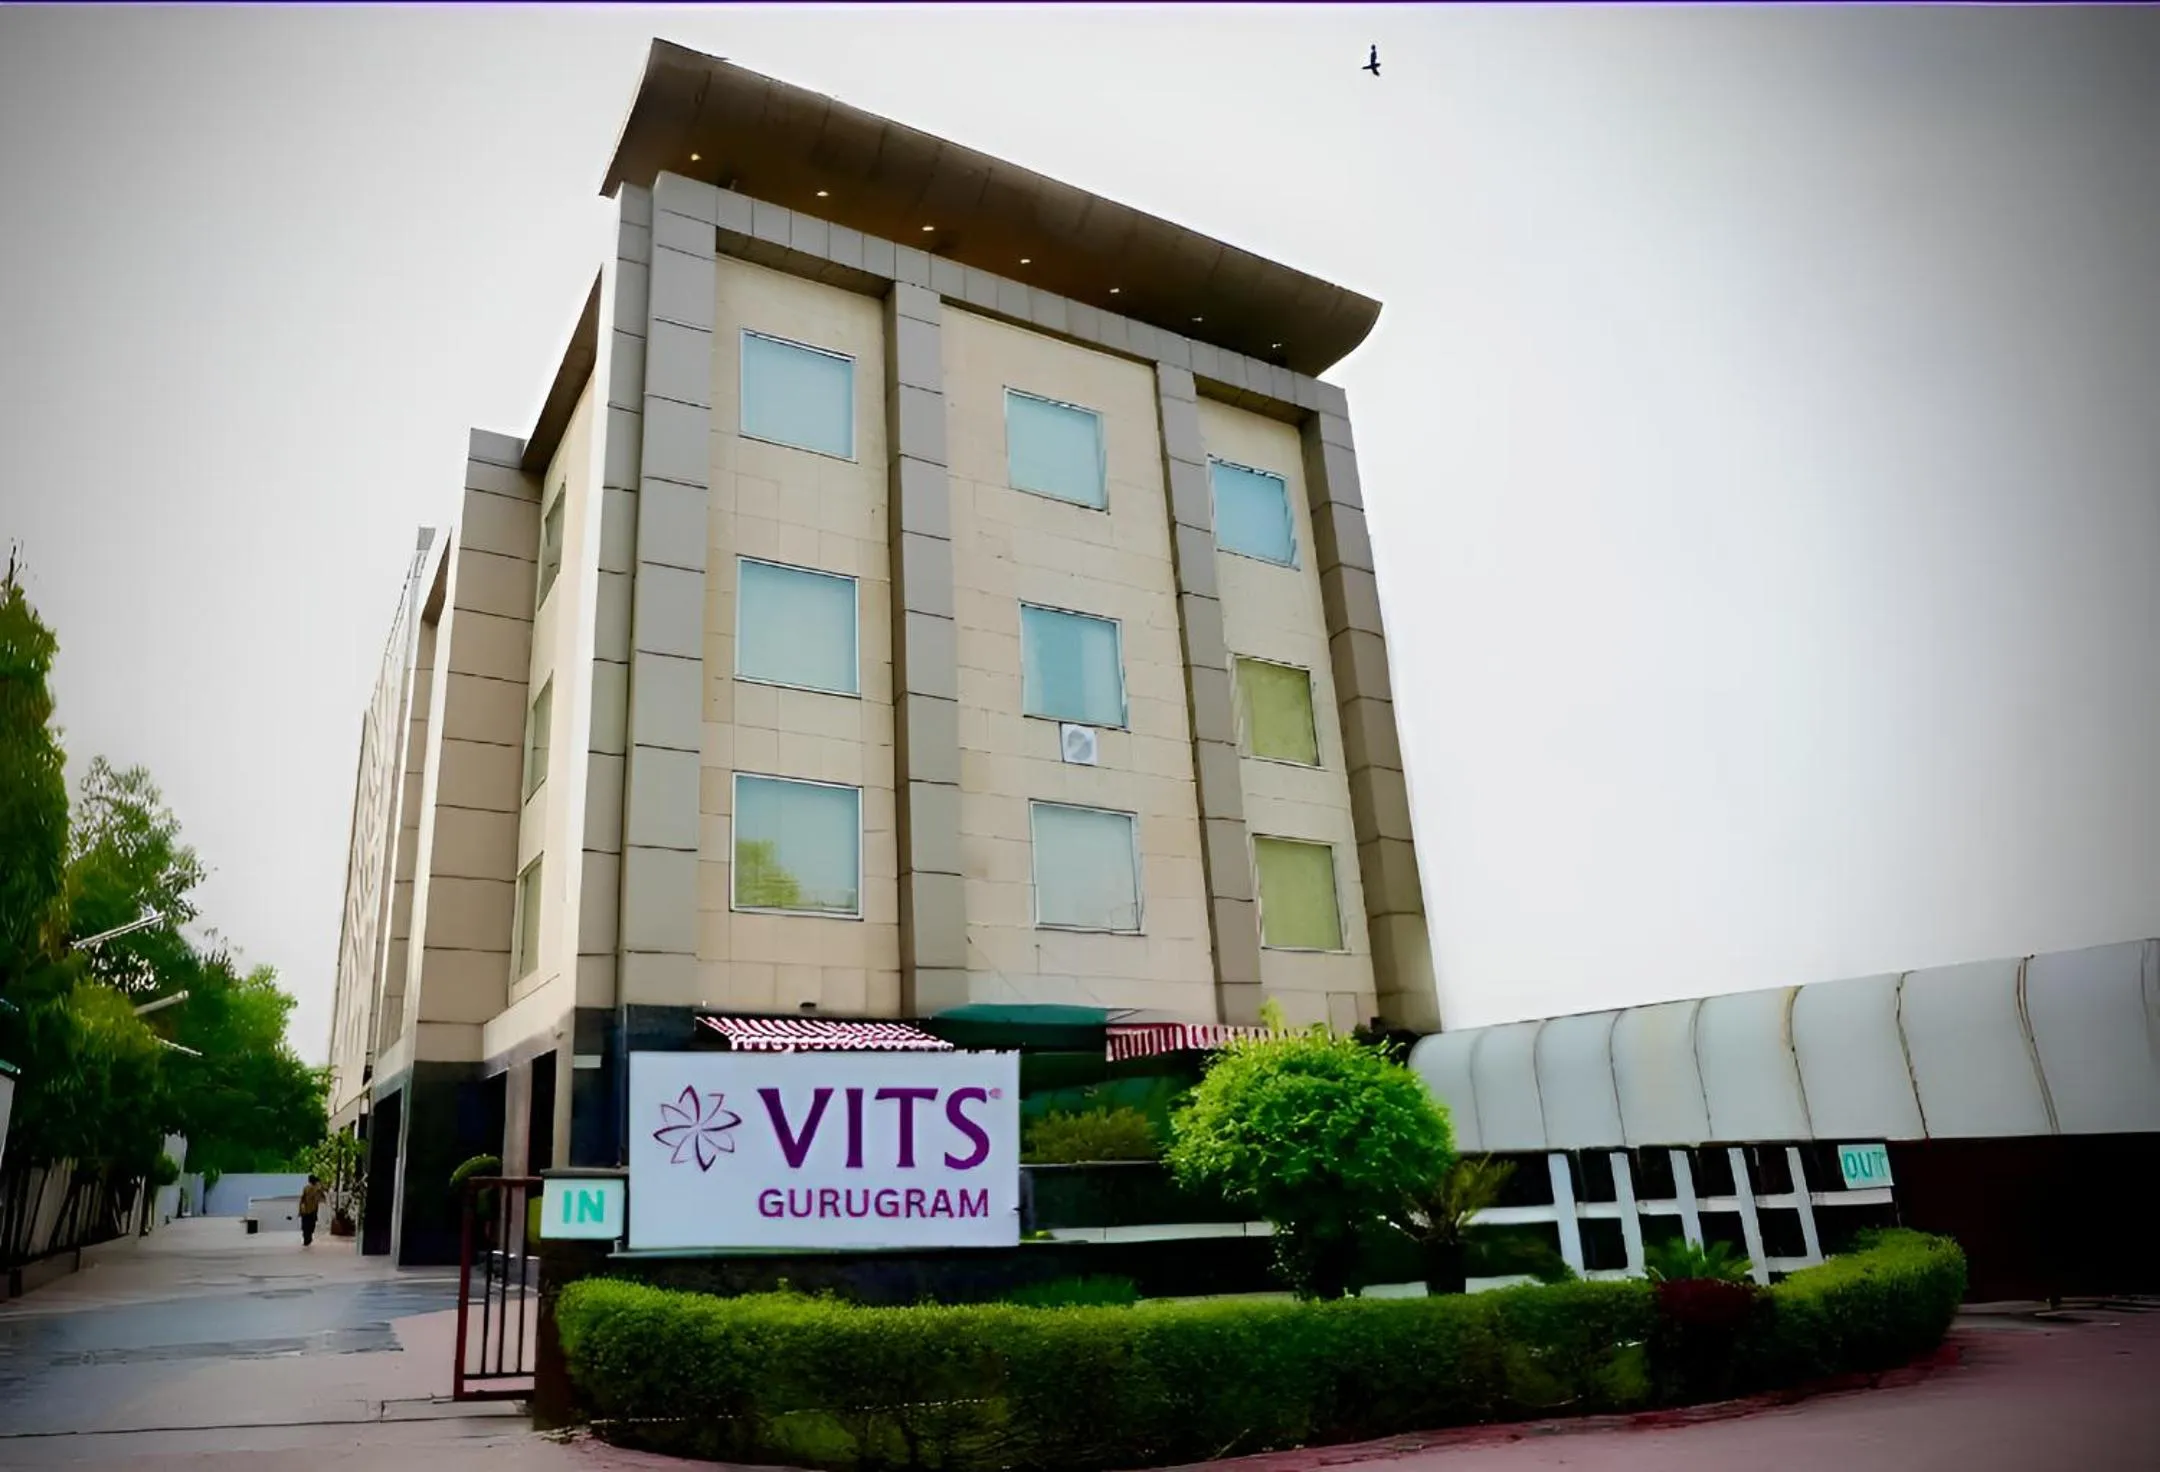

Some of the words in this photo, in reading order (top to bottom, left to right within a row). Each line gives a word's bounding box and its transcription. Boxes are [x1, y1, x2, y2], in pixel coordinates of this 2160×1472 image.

[757, 1087, 990, 1170] VITS
[1843, 1151, 1887, 1179] OUT
[562, 1190, 605, 1224] IN
[758, 1188, 990, 1219] GURUGRAM
